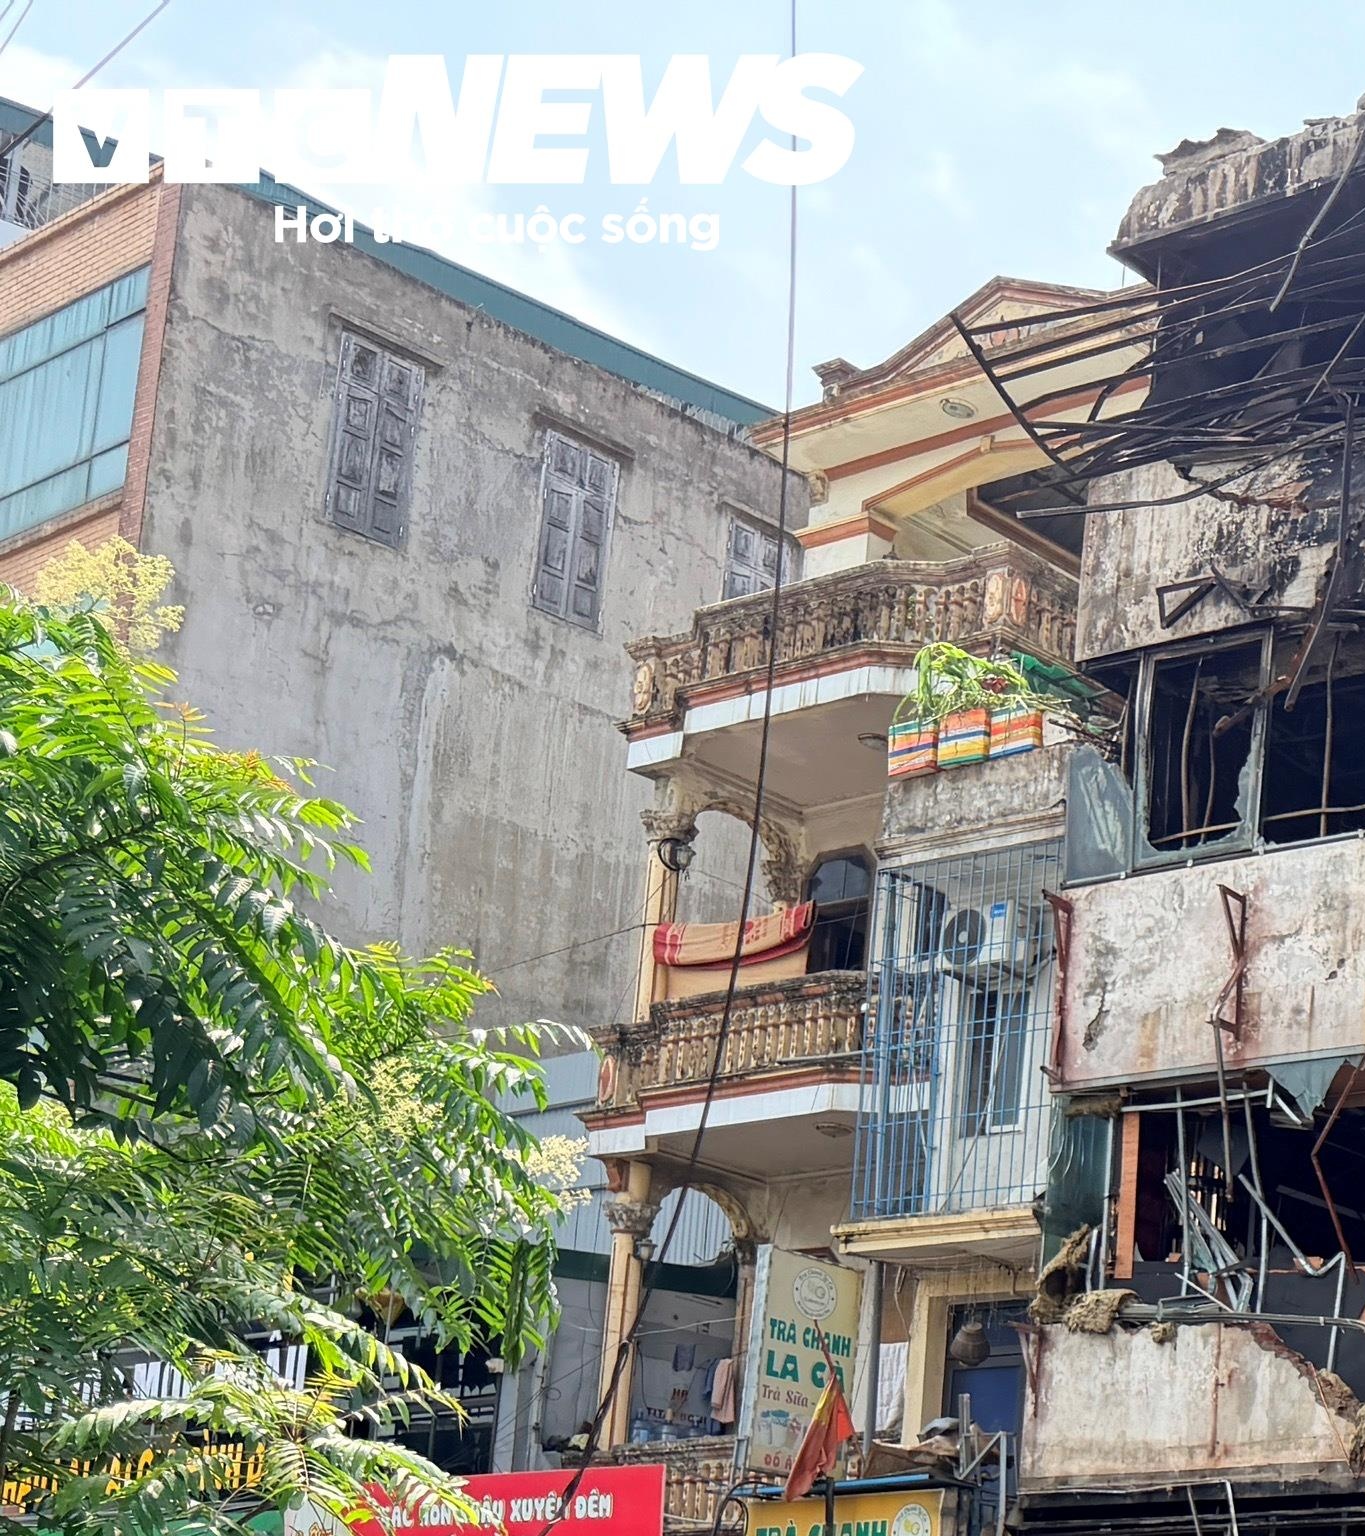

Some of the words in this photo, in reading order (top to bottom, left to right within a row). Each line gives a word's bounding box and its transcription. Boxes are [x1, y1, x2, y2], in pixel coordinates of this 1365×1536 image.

[769, 1318, 797, 1344] TRÀ
[802, 1326, 852, 1358] CHANH
[765, 1350, 799, 1382] LA
[811, 1360, 845, 1393] CÀ
[575, 1488, 614, 1520] ĐÊM
